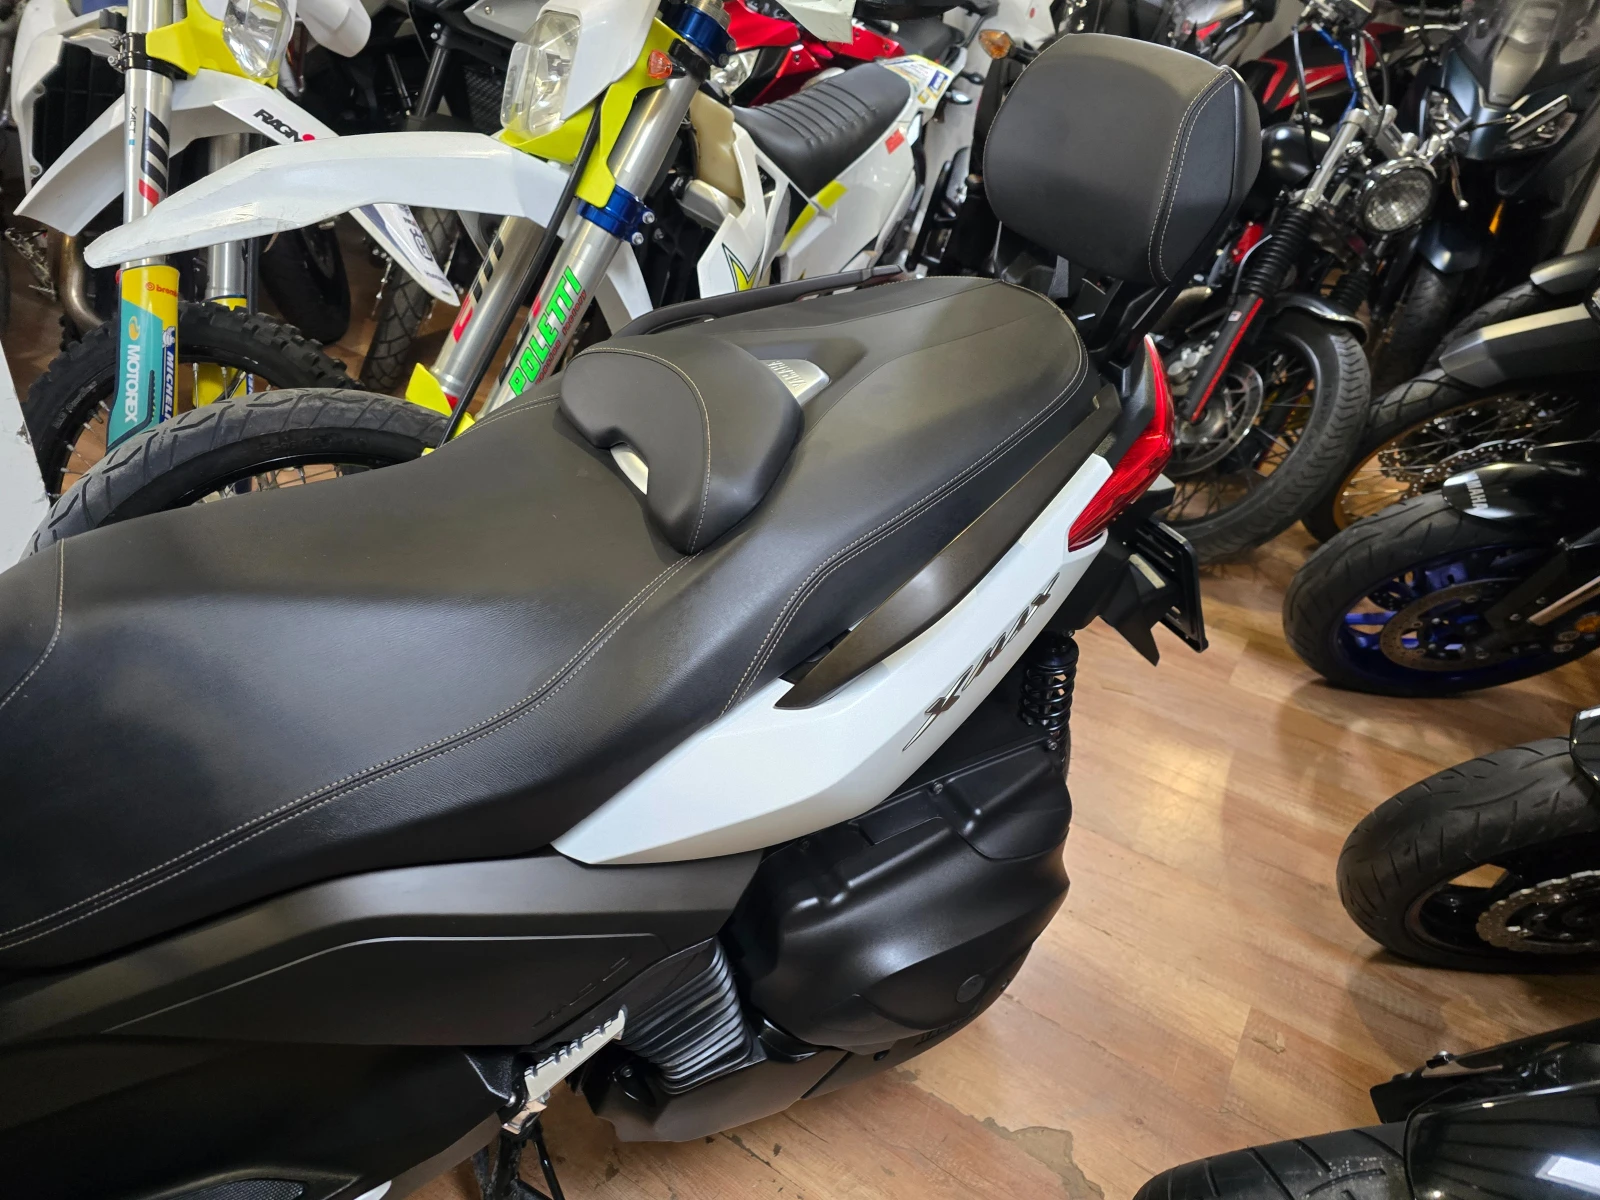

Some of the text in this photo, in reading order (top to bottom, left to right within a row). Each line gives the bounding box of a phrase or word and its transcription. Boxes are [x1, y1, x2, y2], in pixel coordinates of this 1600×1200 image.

[253, 108, 315, 142] RAGN
[508, 265, 582, 396] POLETTI
[124, 345, 140, 423] MOTOREX
